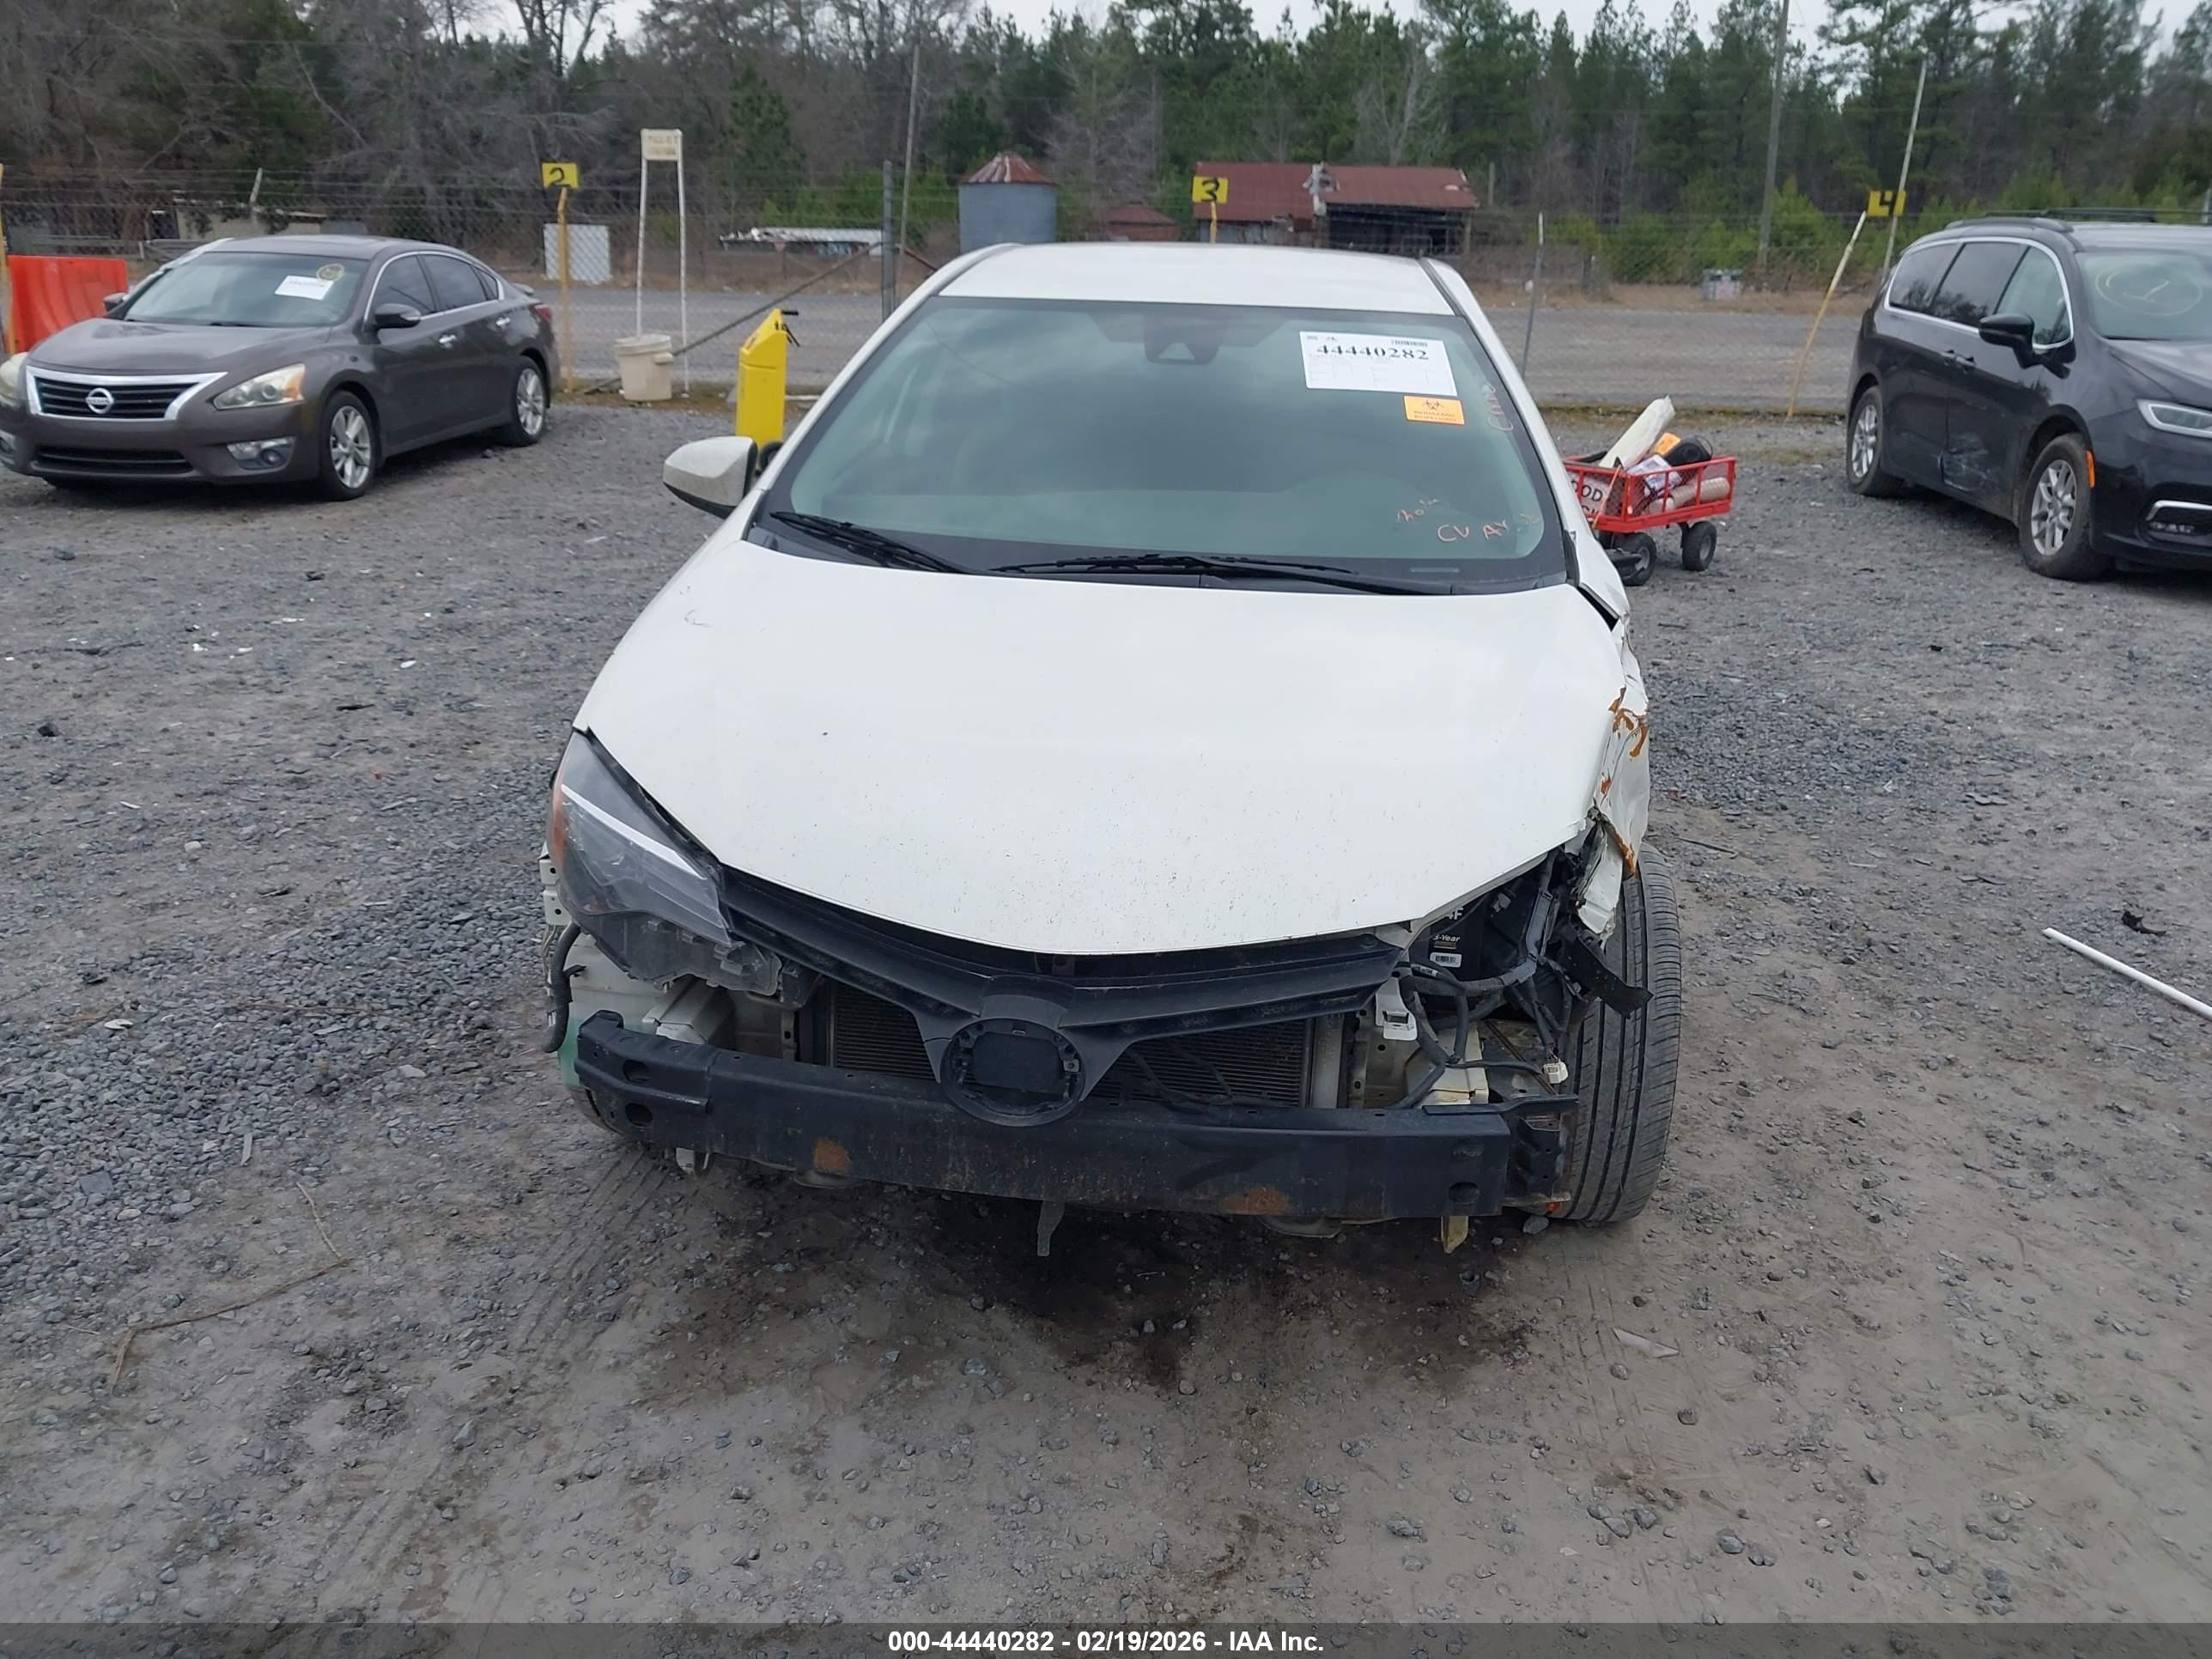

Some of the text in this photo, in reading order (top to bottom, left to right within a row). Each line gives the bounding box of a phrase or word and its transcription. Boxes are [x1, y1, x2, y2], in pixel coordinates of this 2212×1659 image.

[549, 167, 571, 188] 2
[1201, 176, 1219, 202] 3
[1880, 190, 1899, 216] 4
[1316, 344, 1429, 360] 44440282
